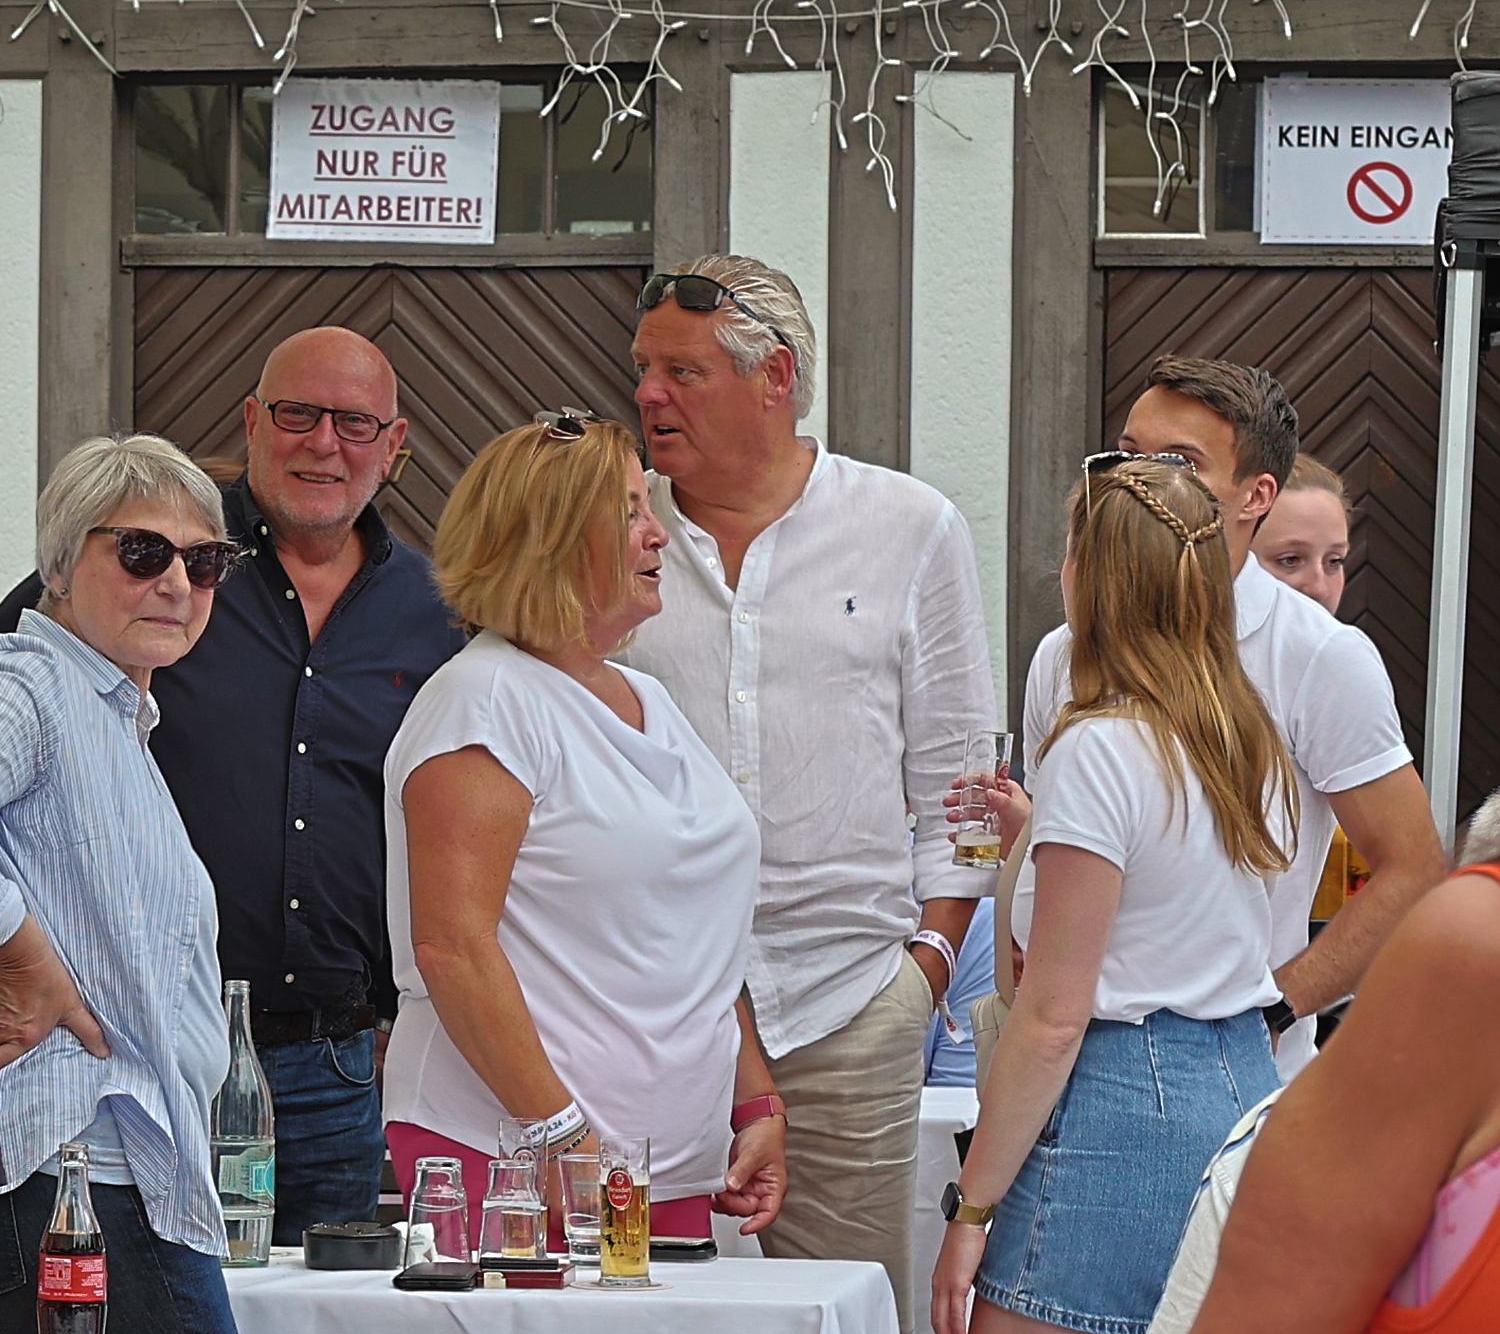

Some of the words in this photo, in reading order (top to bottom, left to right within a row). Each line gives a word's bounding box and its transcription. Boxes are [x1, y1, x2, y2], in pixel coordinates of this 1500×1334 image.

[310, 105, 456, 134] ZUGANG
[1278, 125, 1339, 149] KEIN
[1350, 125, 1455, 149] EINGAN
[316, 151, 380, 177] NUR
[391, 145, 448, 178] FÜR
[277, 194, 483, 225] MITARBEITER!
